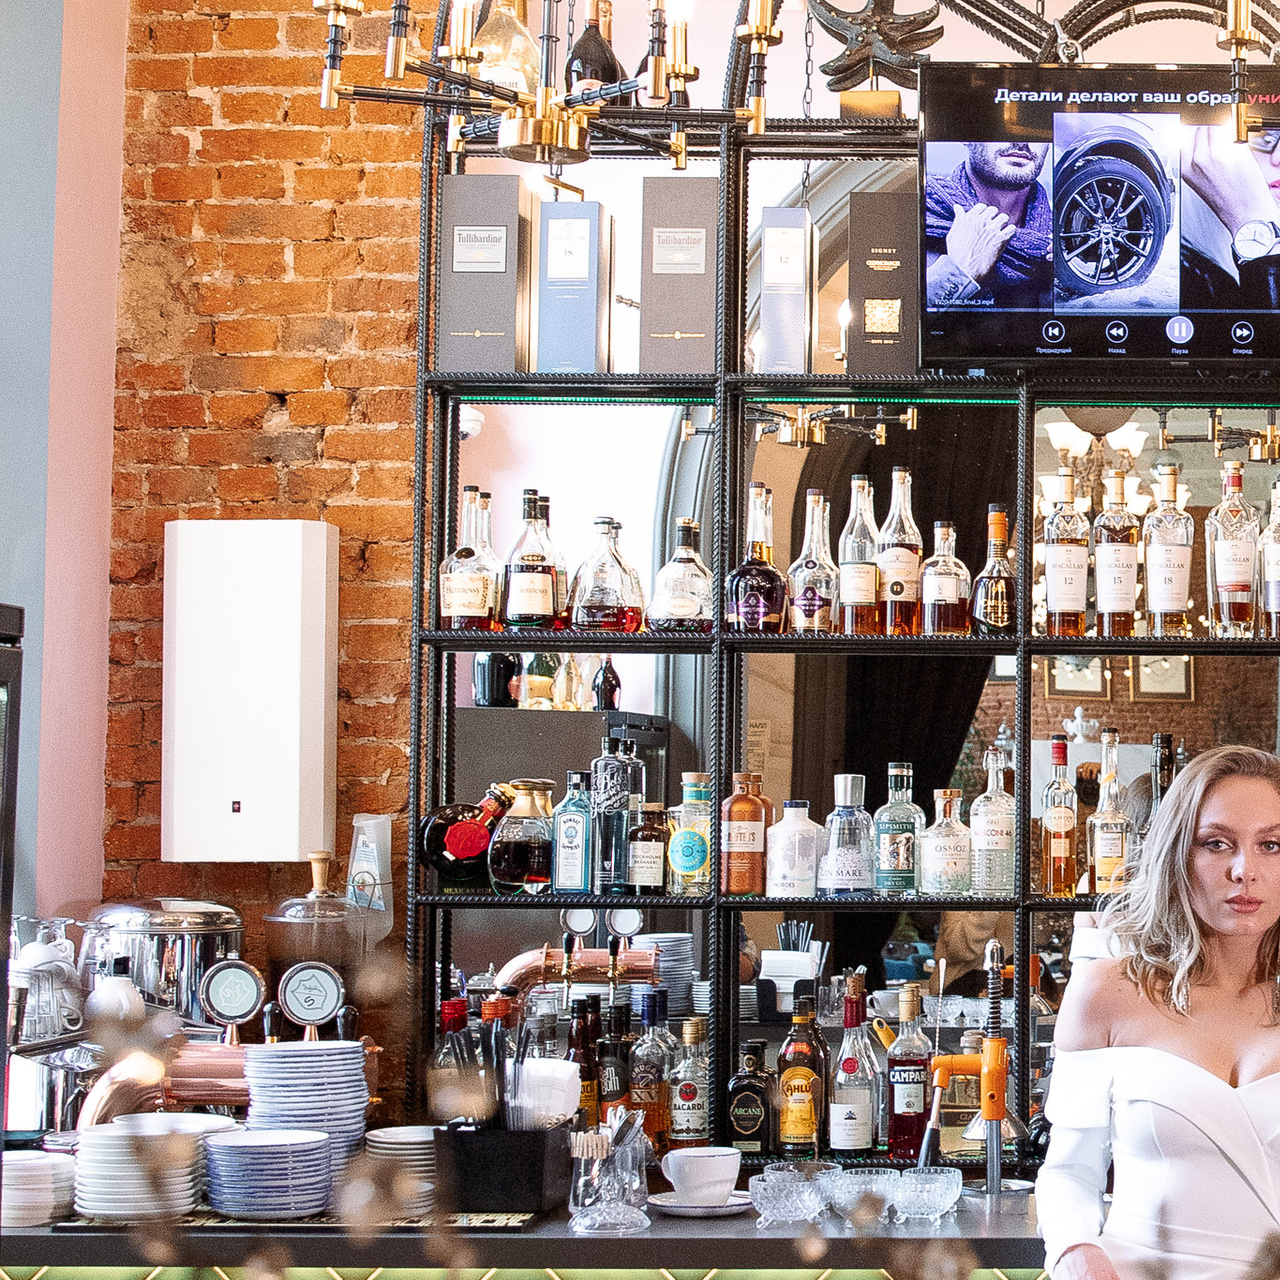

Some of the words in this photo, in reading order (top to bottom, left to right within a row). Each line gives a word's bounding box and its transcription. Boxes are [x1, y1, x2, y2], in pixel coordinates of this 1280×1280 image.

[994, 88, 1064, 104] Детали
[1066, 91, 1138, 104] делают
[1142, 92, 1182, 103] ваш
[1186, 90, 1239, 107] обра
[456, 232, 503, 244] Tullibardine
[656, 234, 704, 246] Tullibardine
[1035, 347, 1072, 355] Предыдущий
[879, 823, 914, 831] SIPSMITH
[934, 844, 967, 853] OSMOZ
[836, 869, 863, 877] MARE
[632, 1091, 659, 1103] XV
[733, 1107, 763, 1116] ARCANE
